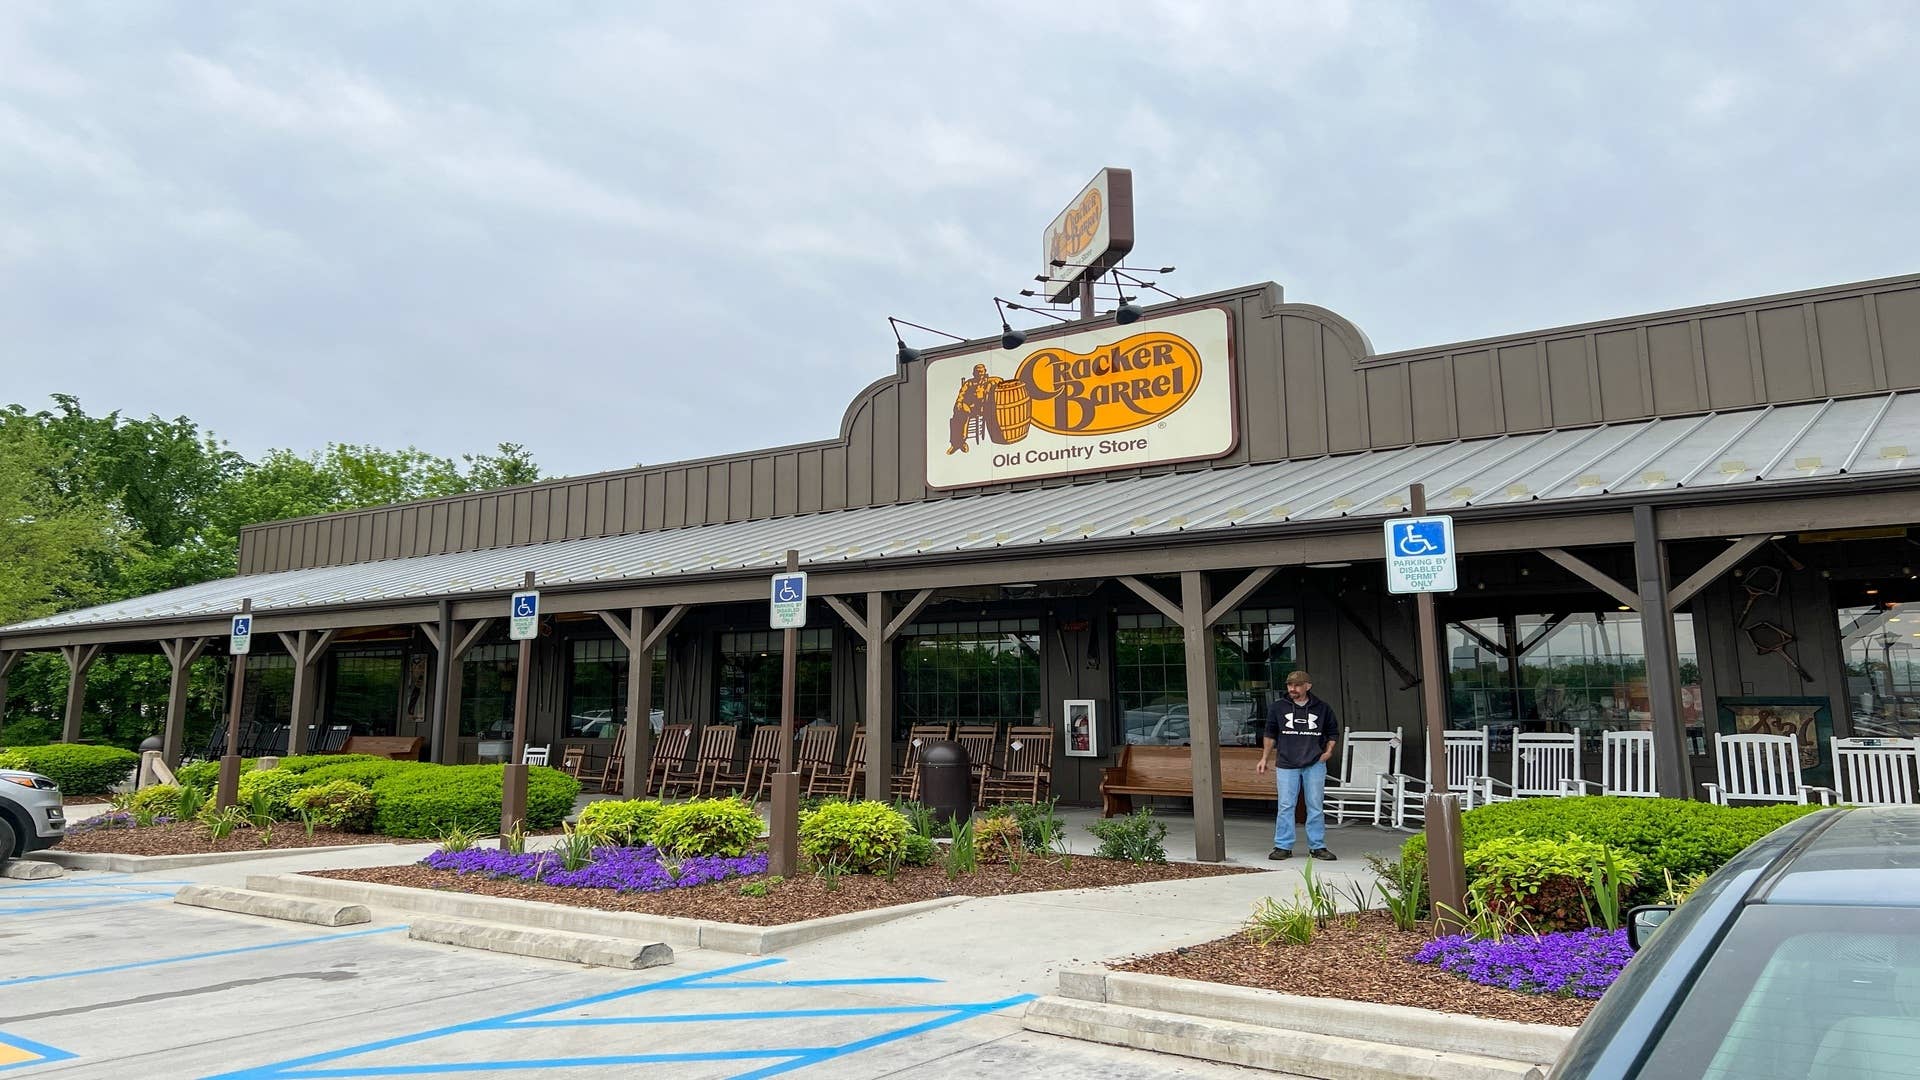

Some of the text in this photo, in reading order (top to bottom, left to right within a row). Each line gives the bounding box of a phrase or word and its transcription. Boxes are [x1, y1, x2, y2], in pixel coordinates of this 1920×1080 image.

[1019, 344, 1175, 400] Cracker
[1053, 366, 1184, 430] Barrel
[993, 438, 1148, 468] Old Country Store
